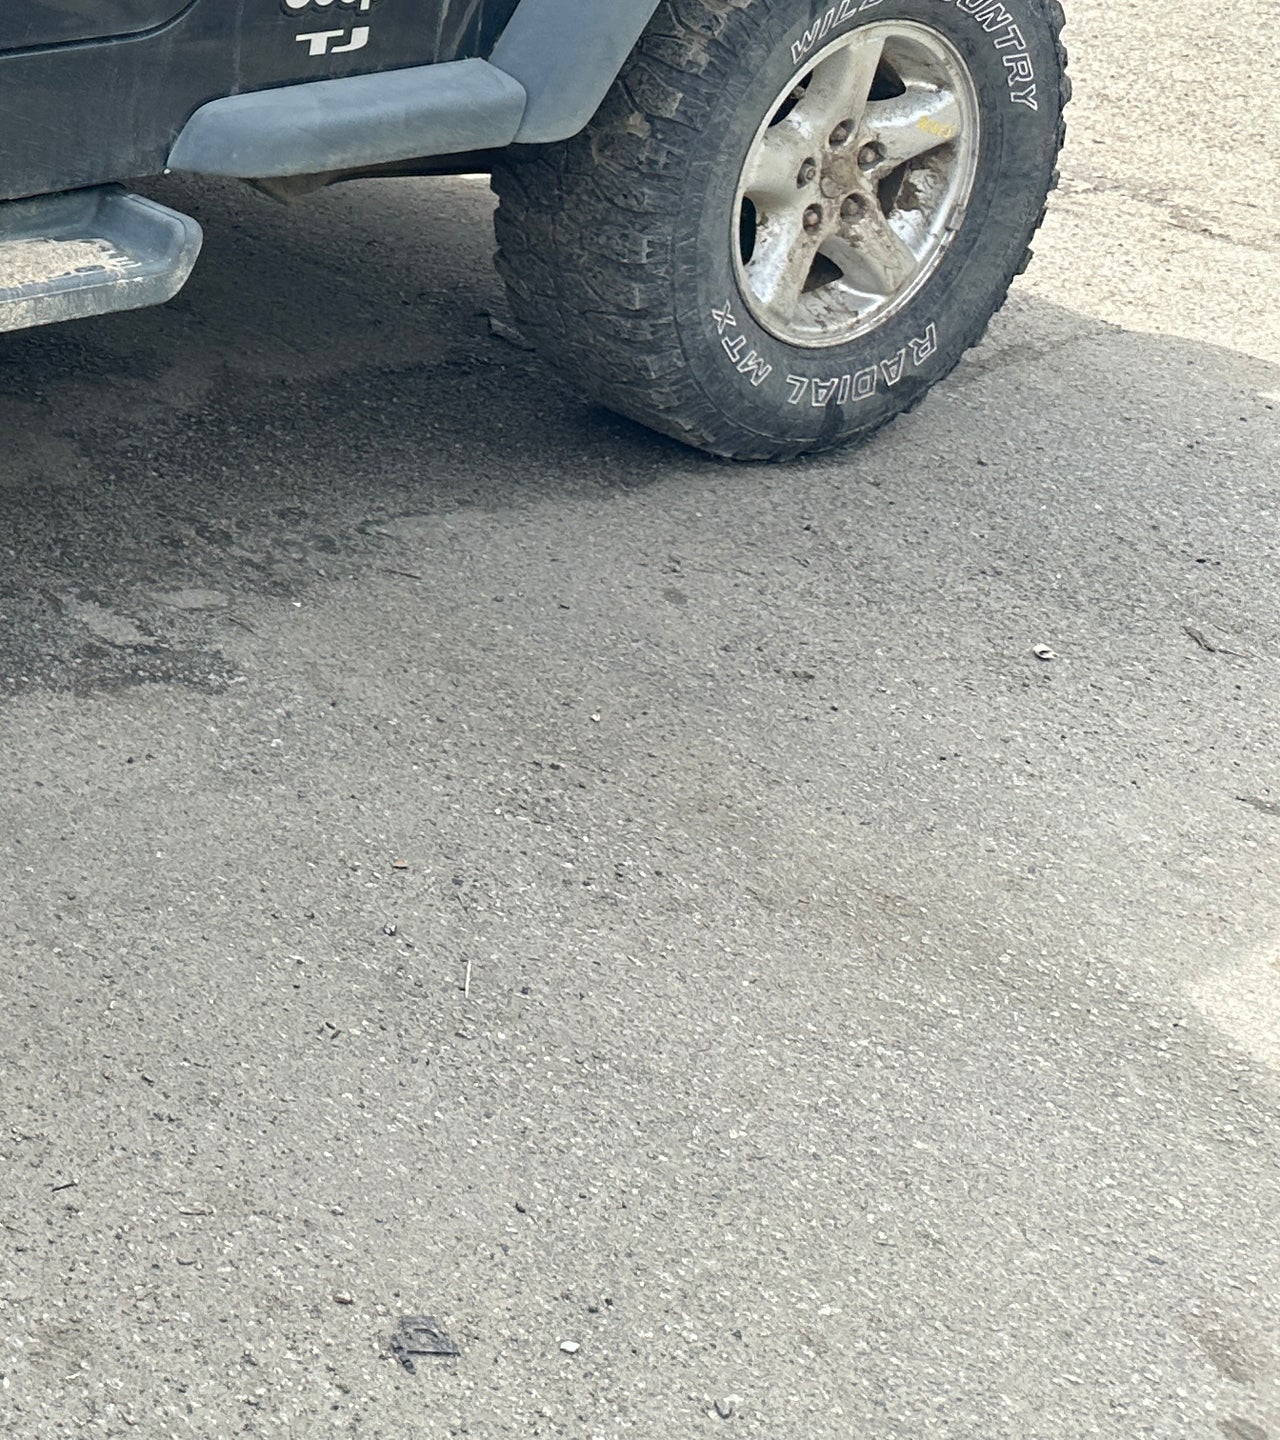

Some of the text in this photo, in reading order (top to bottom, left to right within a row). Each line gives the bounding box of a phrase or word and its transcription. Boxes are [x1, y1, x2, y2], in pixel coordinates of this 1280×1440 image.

[295, 25, 370, 56] TJ
[711, 298, 939, 408] RADIAL MTX
